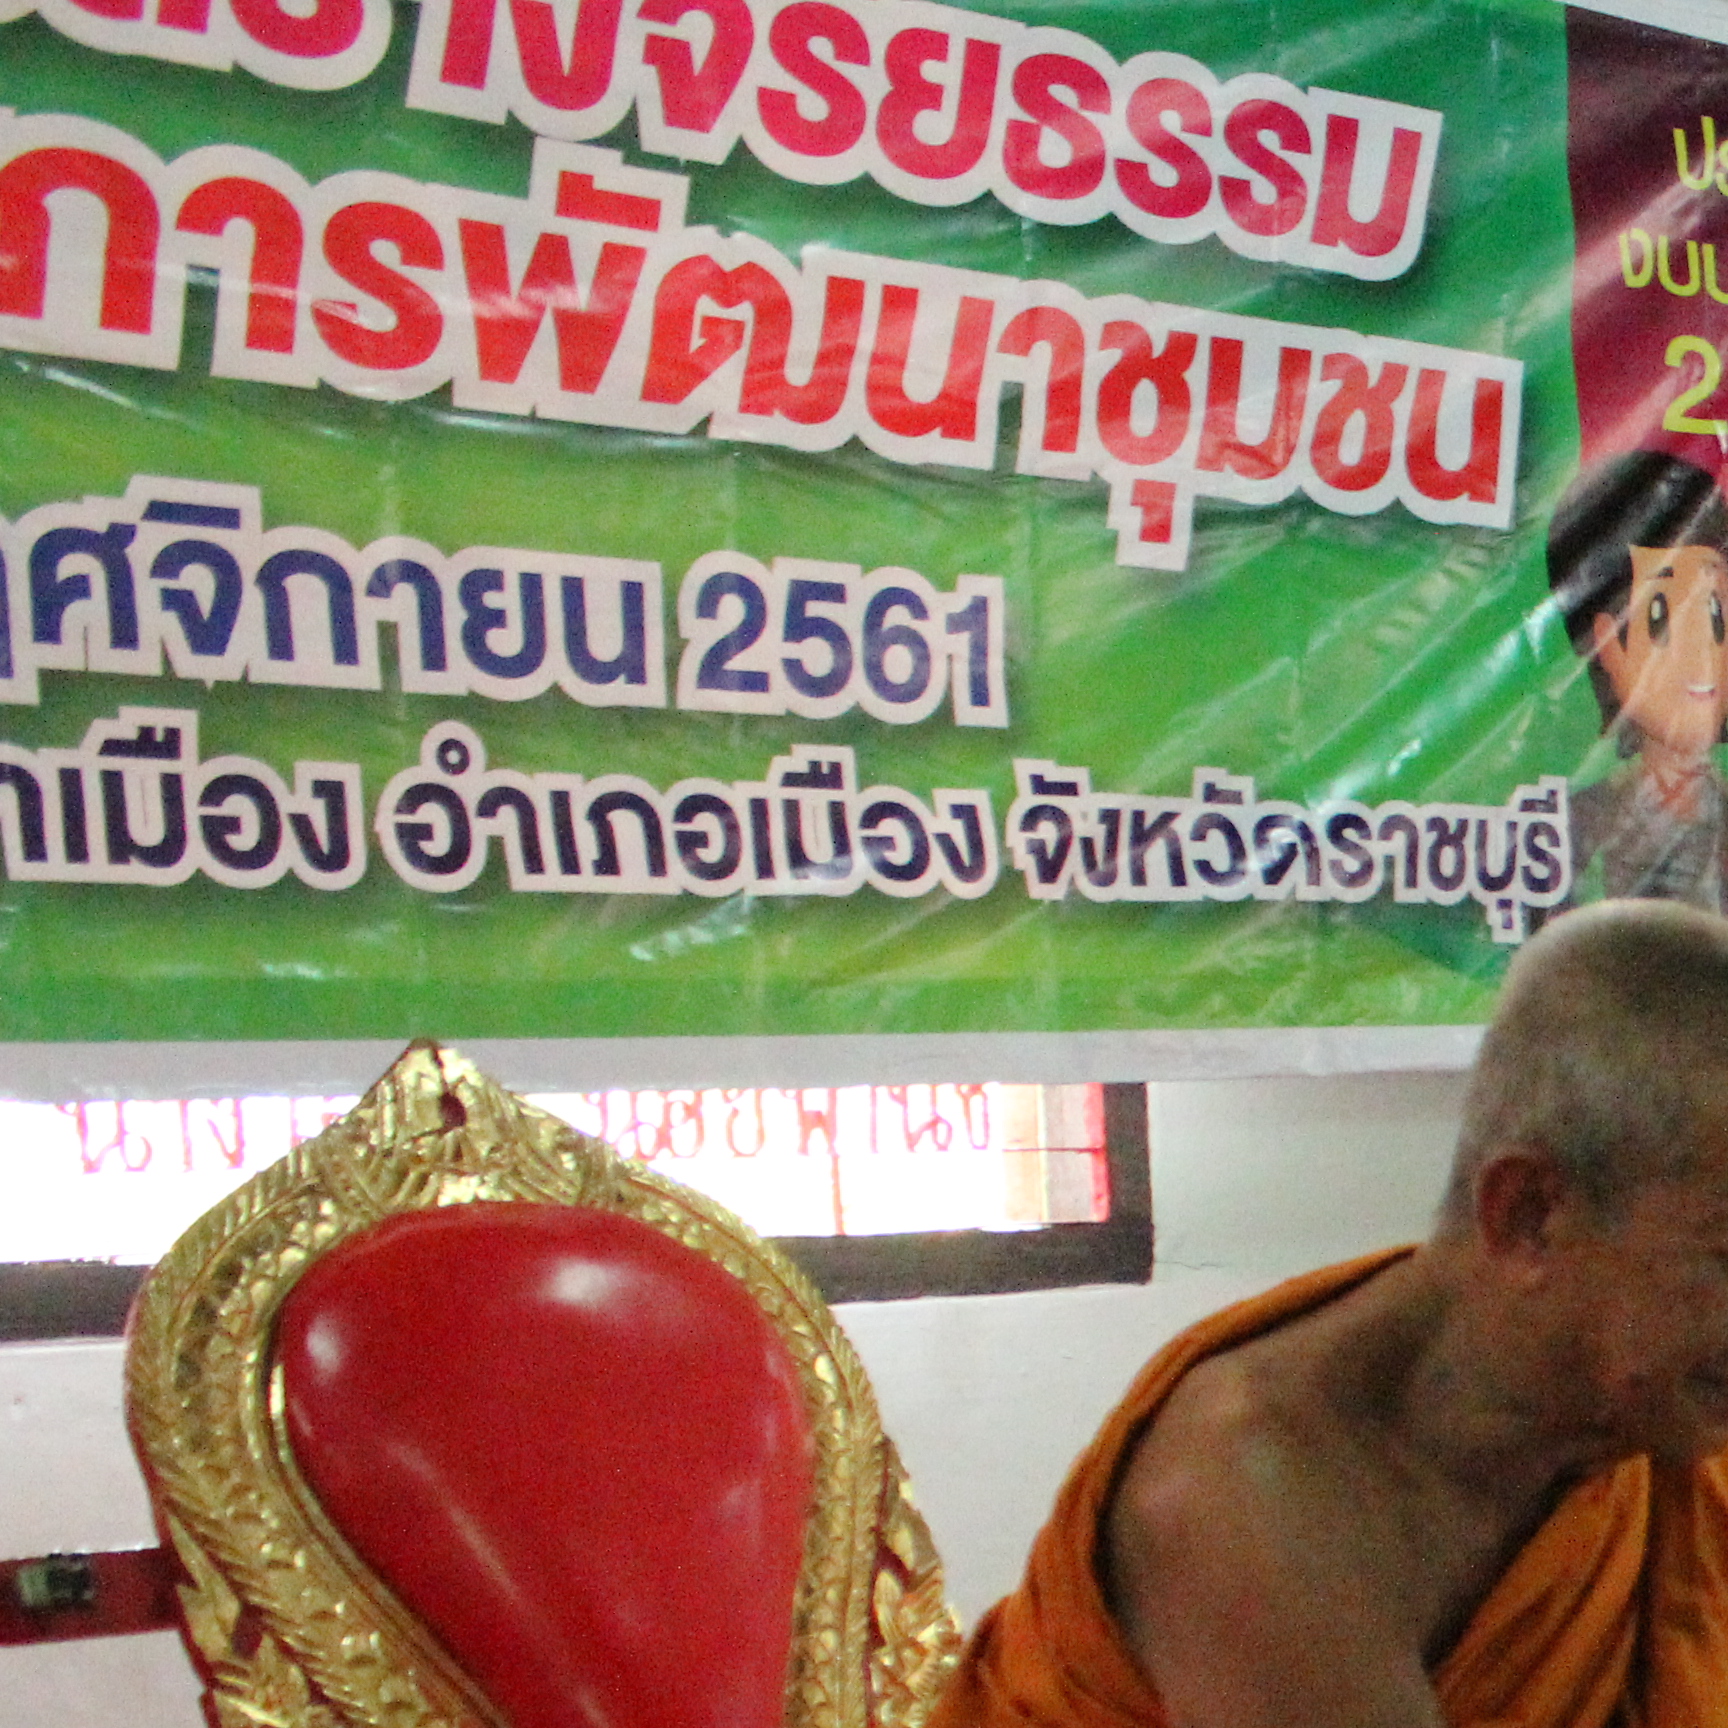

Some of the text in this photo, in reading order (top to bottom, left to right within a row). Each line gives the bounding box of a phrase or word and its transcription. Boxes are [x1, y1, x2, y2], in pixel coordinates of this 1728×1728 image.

[0, 500, 992, 708] ศจิกายน 2561
[395, 739, 984, 884] อำเภอเมือง
[1019, 773, 1562, 930] จังหวัดราชบุรี
